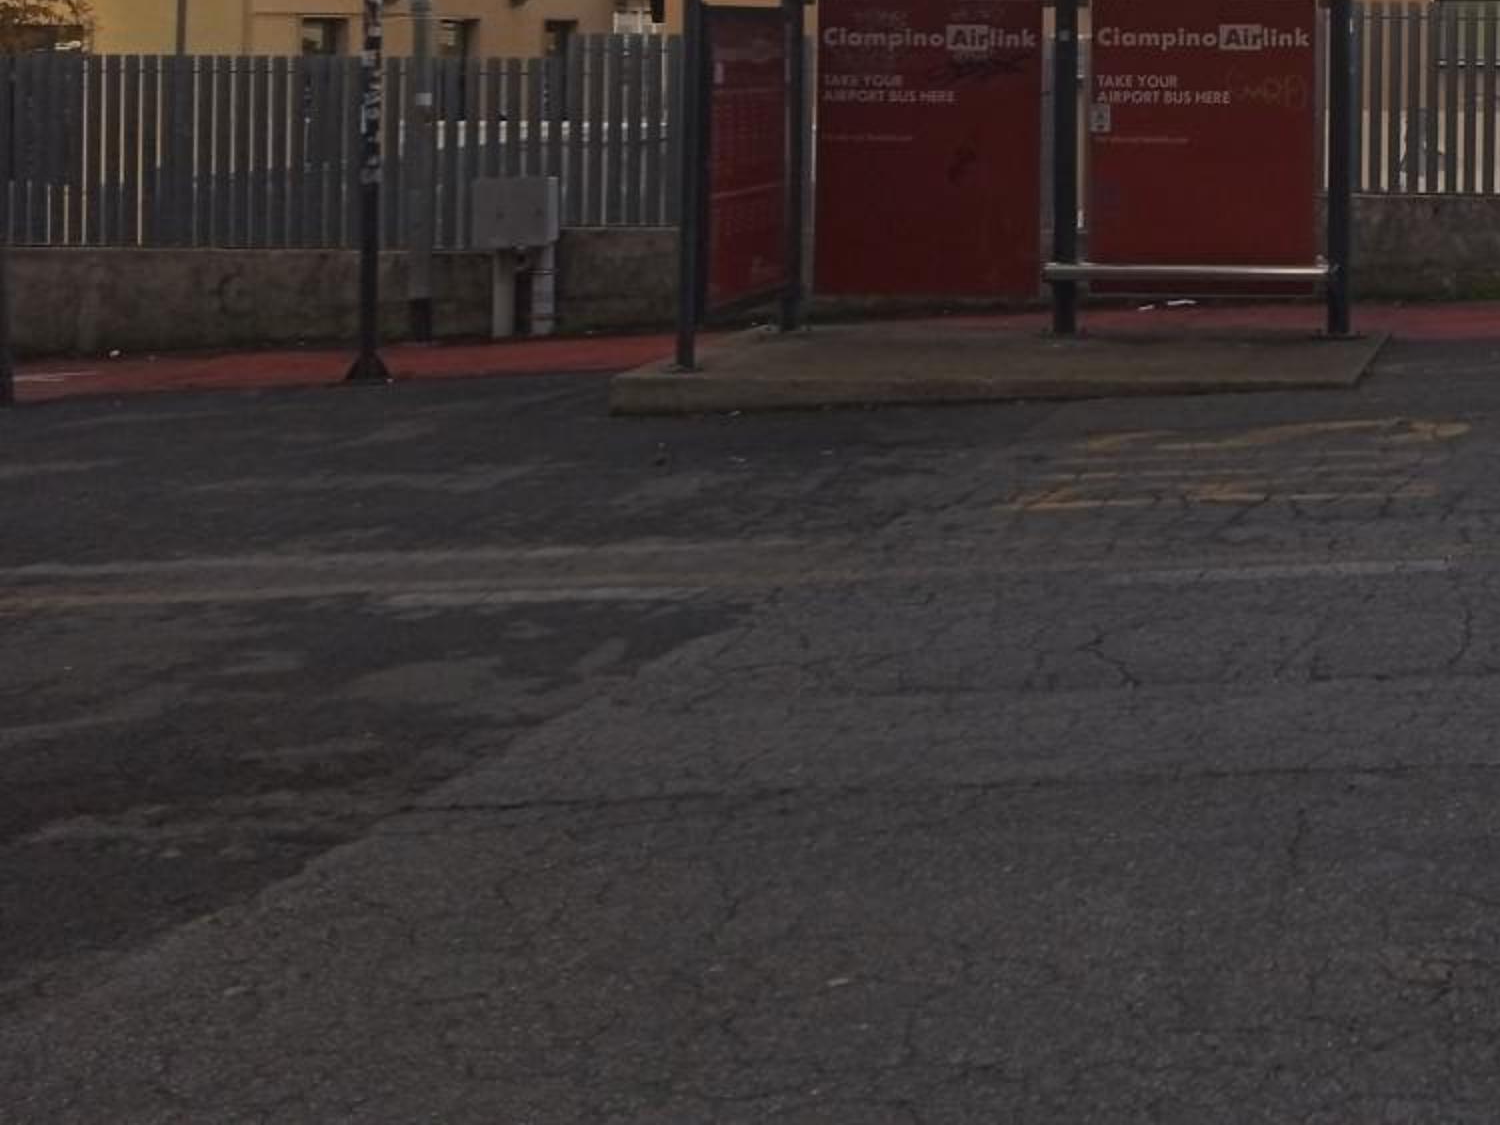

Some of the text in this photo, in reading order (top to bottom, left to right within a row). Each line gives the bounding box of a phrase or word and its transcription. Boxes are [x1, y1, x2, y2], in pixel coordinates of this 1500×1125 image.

[823, 26, 1036, 51] Ciampino Airlink
[1096, 26, 1311, 51] Ciampino Airlink
[823, 74, 904, 88] TAKE YOUR
[1096, 74, 1178, 88] TAKE YOUR
[823, 90, 957, 103] AIRPORT BUS HERE
[1096, 90, 1232, 104] AIRPORT BUS HERE
